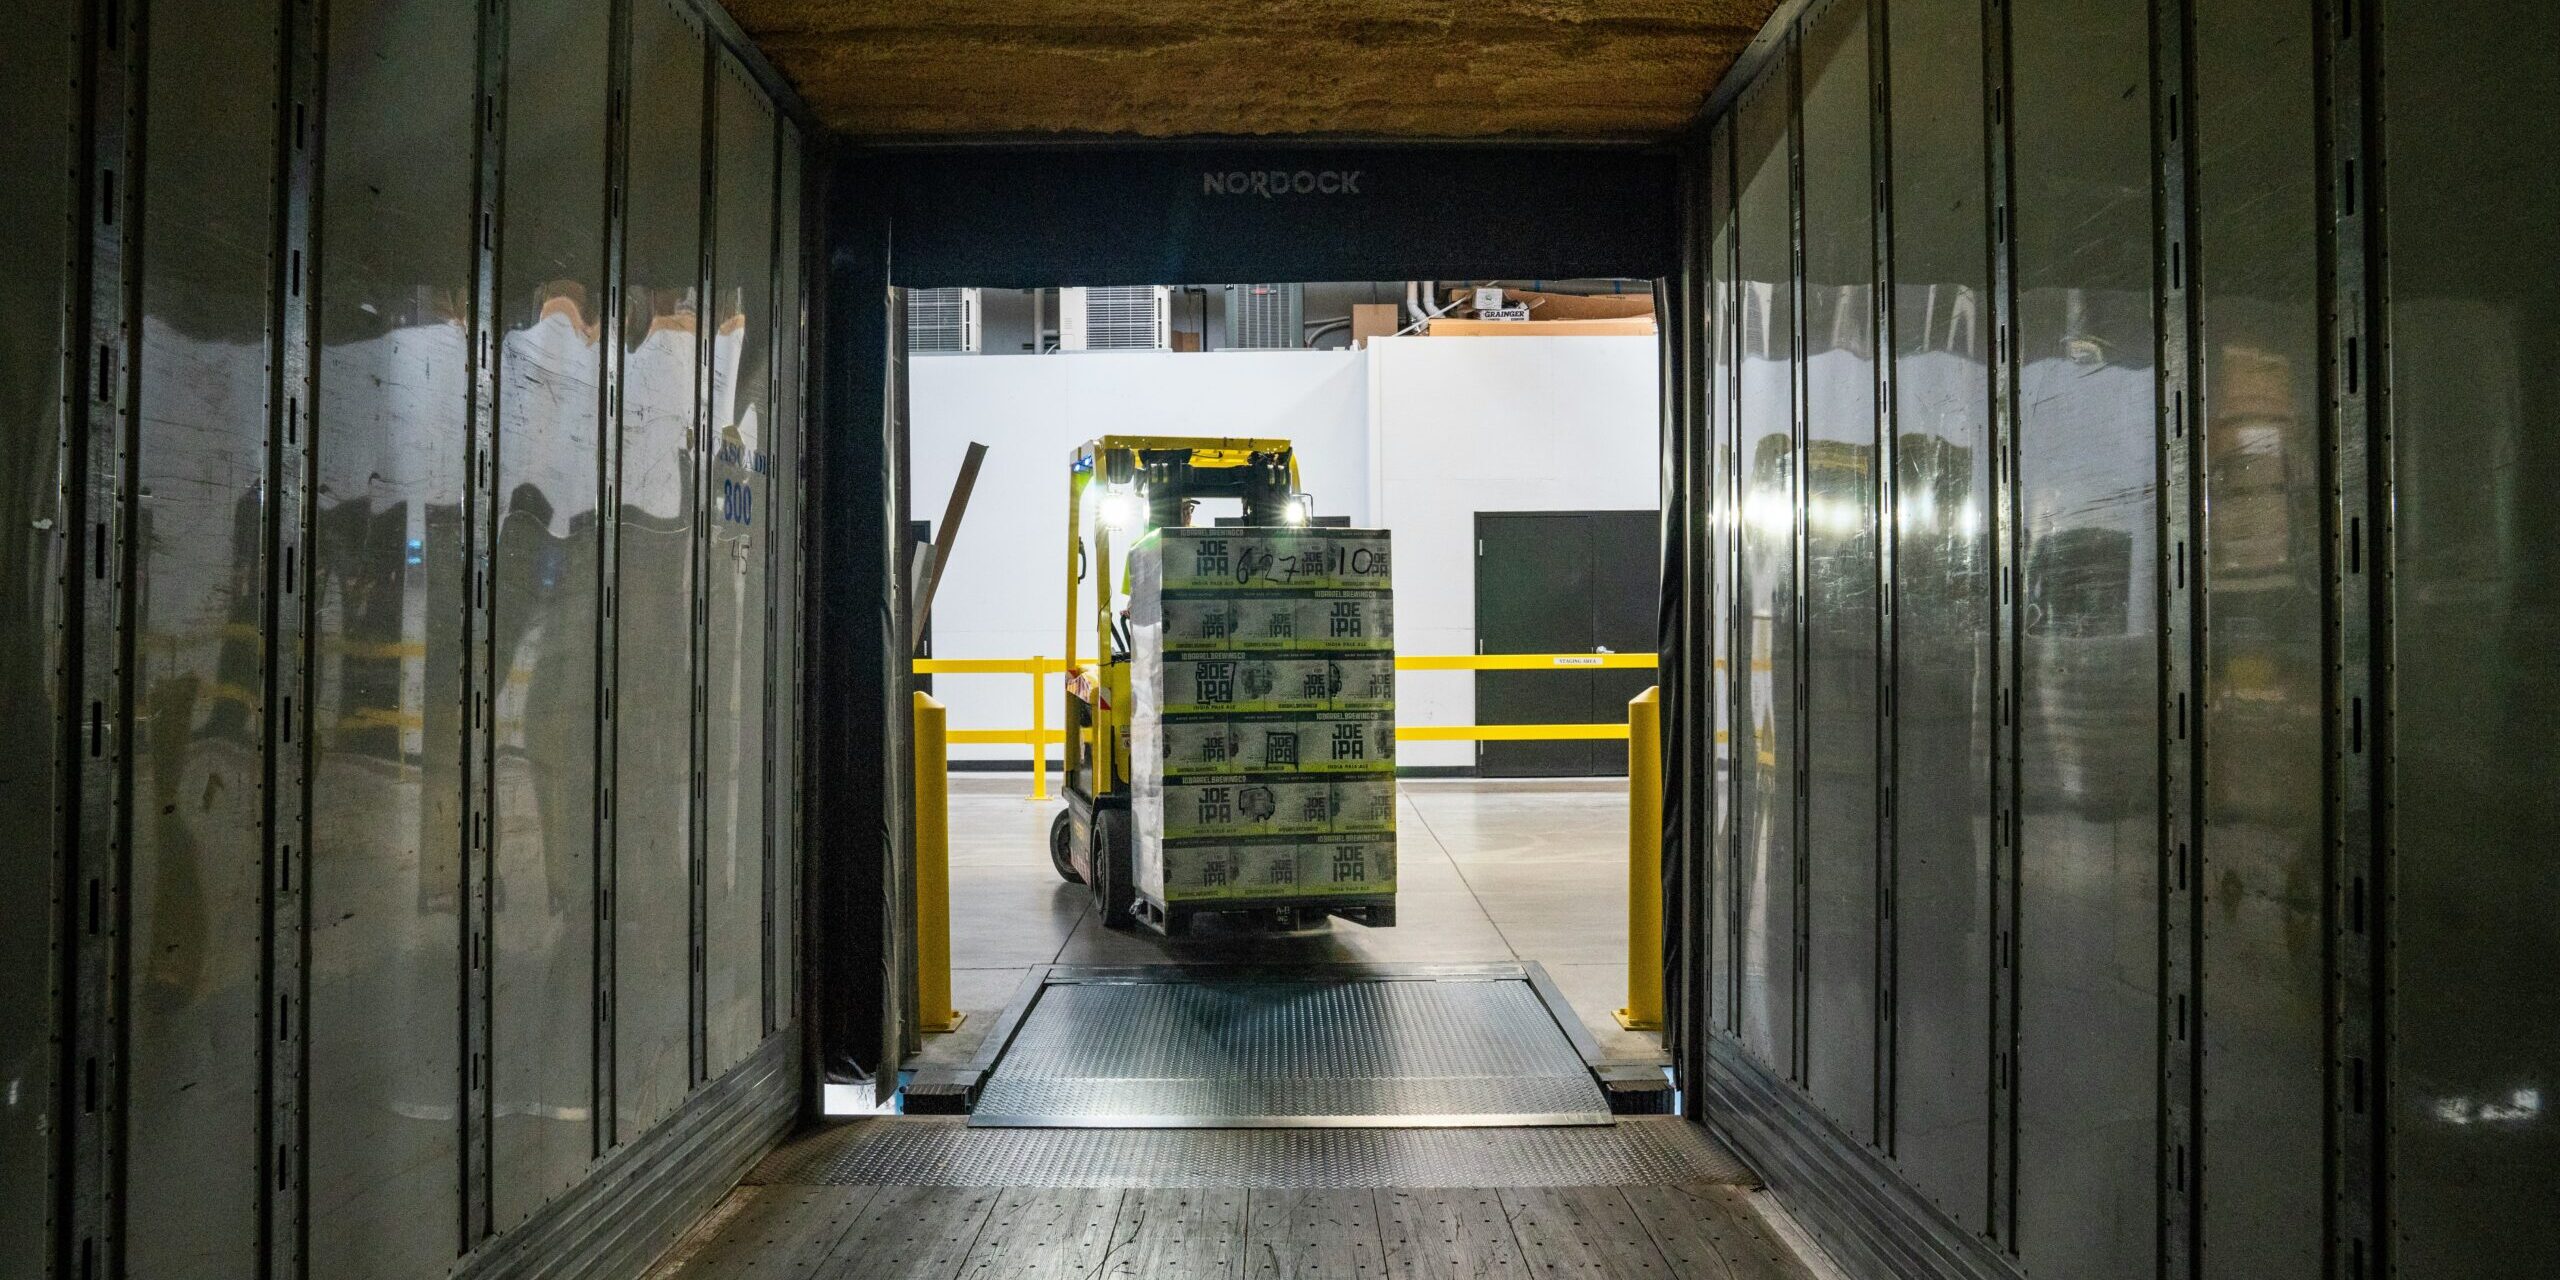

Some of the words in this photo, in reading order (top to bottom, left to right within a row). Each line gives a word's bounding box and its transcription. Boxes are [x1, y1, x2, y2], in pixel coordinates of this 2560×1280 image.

[1203, 171, 1361, 198] NORDOCK
[724, 478, 752, 526] 800
[1197, 540, 1228, 556] JOE
[1302, 552, 1322, 562] JOE
[1340, 546, 1373, 575] 10
[1197, 557, 1228, 576] IPA
[1302, 563, 1323, 576] IPA
[1330, 602, 1360, 617] JOE
[1202, 614, 1224, 624] JOE
[1270, 613, 1291, 624] JOE
[1202, 625, 1224, 638] IPA
[1270, 625, 1291, 637] IPA
[1330, 618, 1361, 637] IPA
[1198, 664, 1229, 679] JOE
[1304, 674, 1325, 684] JOE
[1370, 674, 1391, 684] JOE
[1198, 681, 1230, 701] IPA
[1304, 685, 1325, 698] IPA
[1370, 685, 1391, 698] IPA
[1332, 724, 1362, 739] JOE
[1203, 737, 1224, 748] JOE
[1270, 737, 1291, 747] JOE
[1203, 749, 1225, 762] IPA
[1270, 748, 1291, 761] IPA
[1332, 740, 1363, 759] IPA
[1198, 787, 1230, 803] JOE
[1370, 796, 1391, 806] JOE
[1304, 797, 1325, 808] JOE
[1199, 804, 1231, 824] IPA
[1304, 808, 1325, 821] IPA
[1370, 807, 1391, 820] IPA
[1333, 846, 1364, 861] JOE
[1204, 861, 1225, 872] JOE
[1271, 859, 1292, 870] JOE
[1271, 871, 1293, 884] IPA
[1333, 862, 1364, 881] IPA
[1204, 873, 1226, 886] IPA
